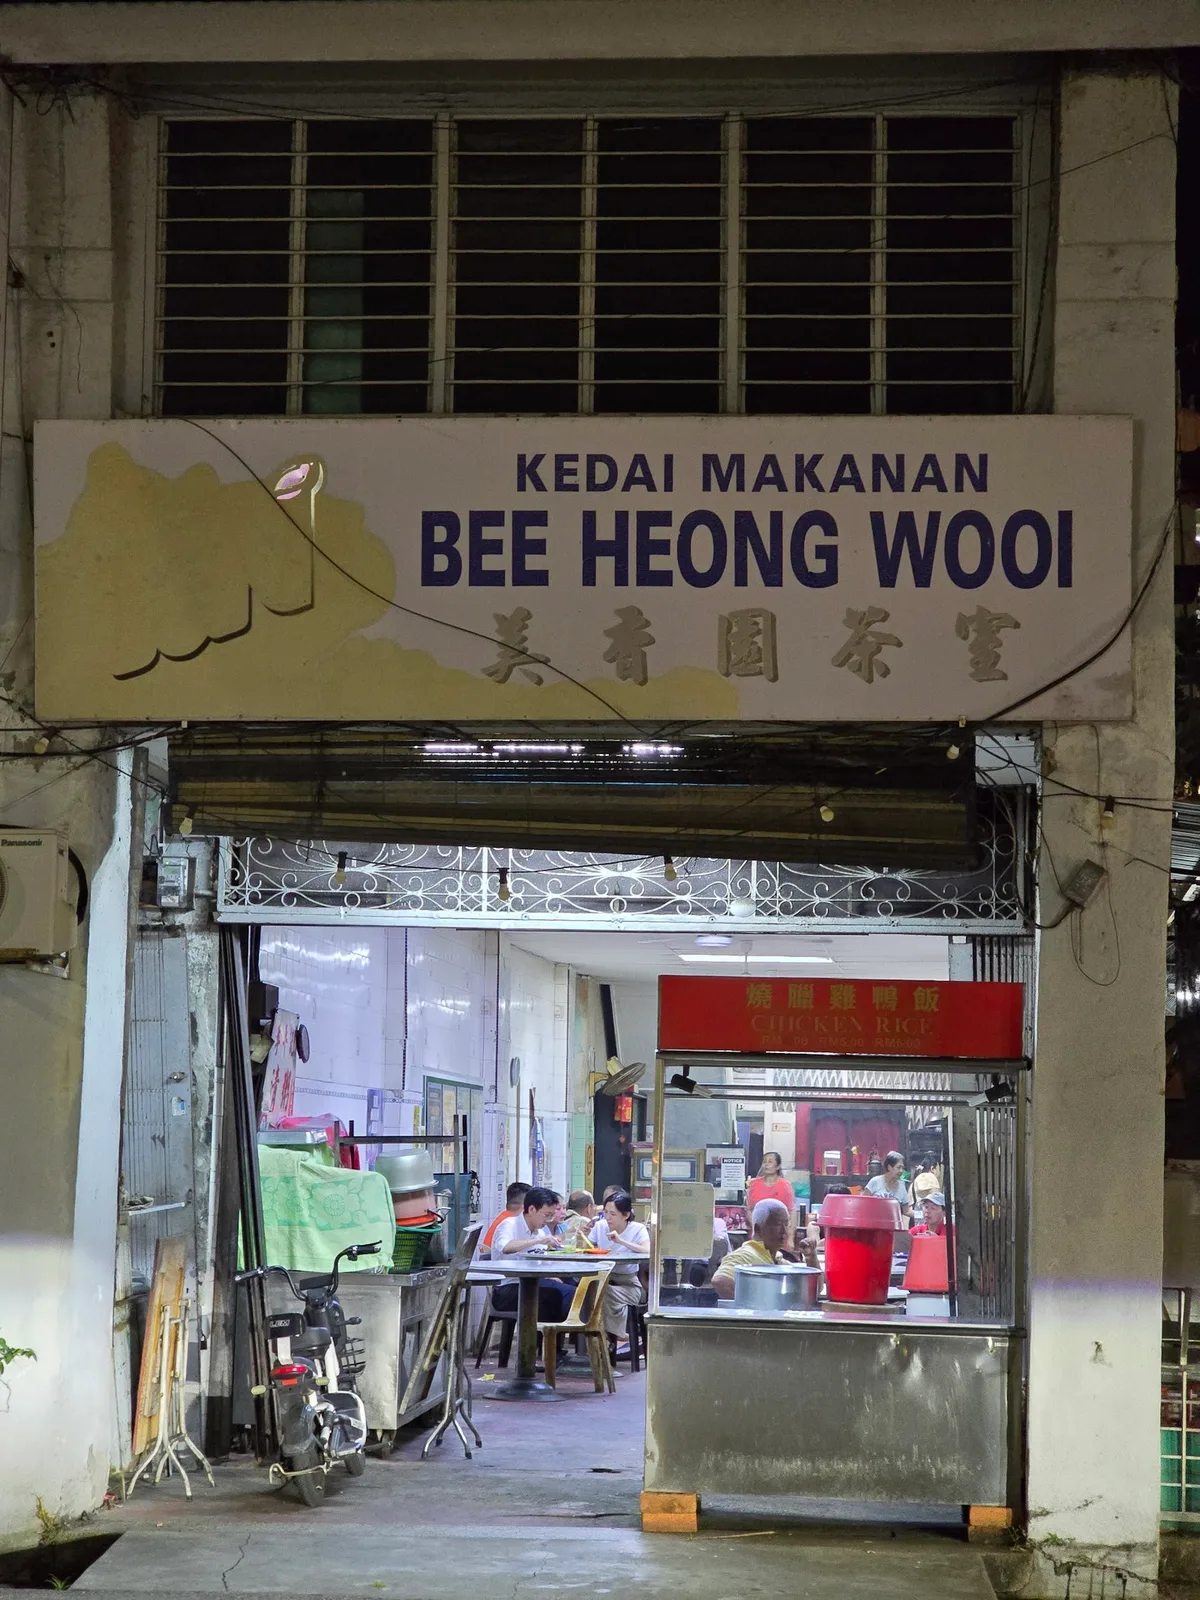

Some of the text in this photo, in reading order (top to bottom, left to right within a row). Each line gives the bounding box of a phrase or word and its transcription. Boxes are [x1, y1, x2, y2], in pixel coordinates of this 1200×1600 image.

[516, 453, 989, 493] KEDAI MAKANAN
[420, 508, 1074, 589] BEE HEONG WOOI
[481, 604, 1021, 686] 美香園茶室
[751, 1013, 935, 1035] CHICKEN RICE
